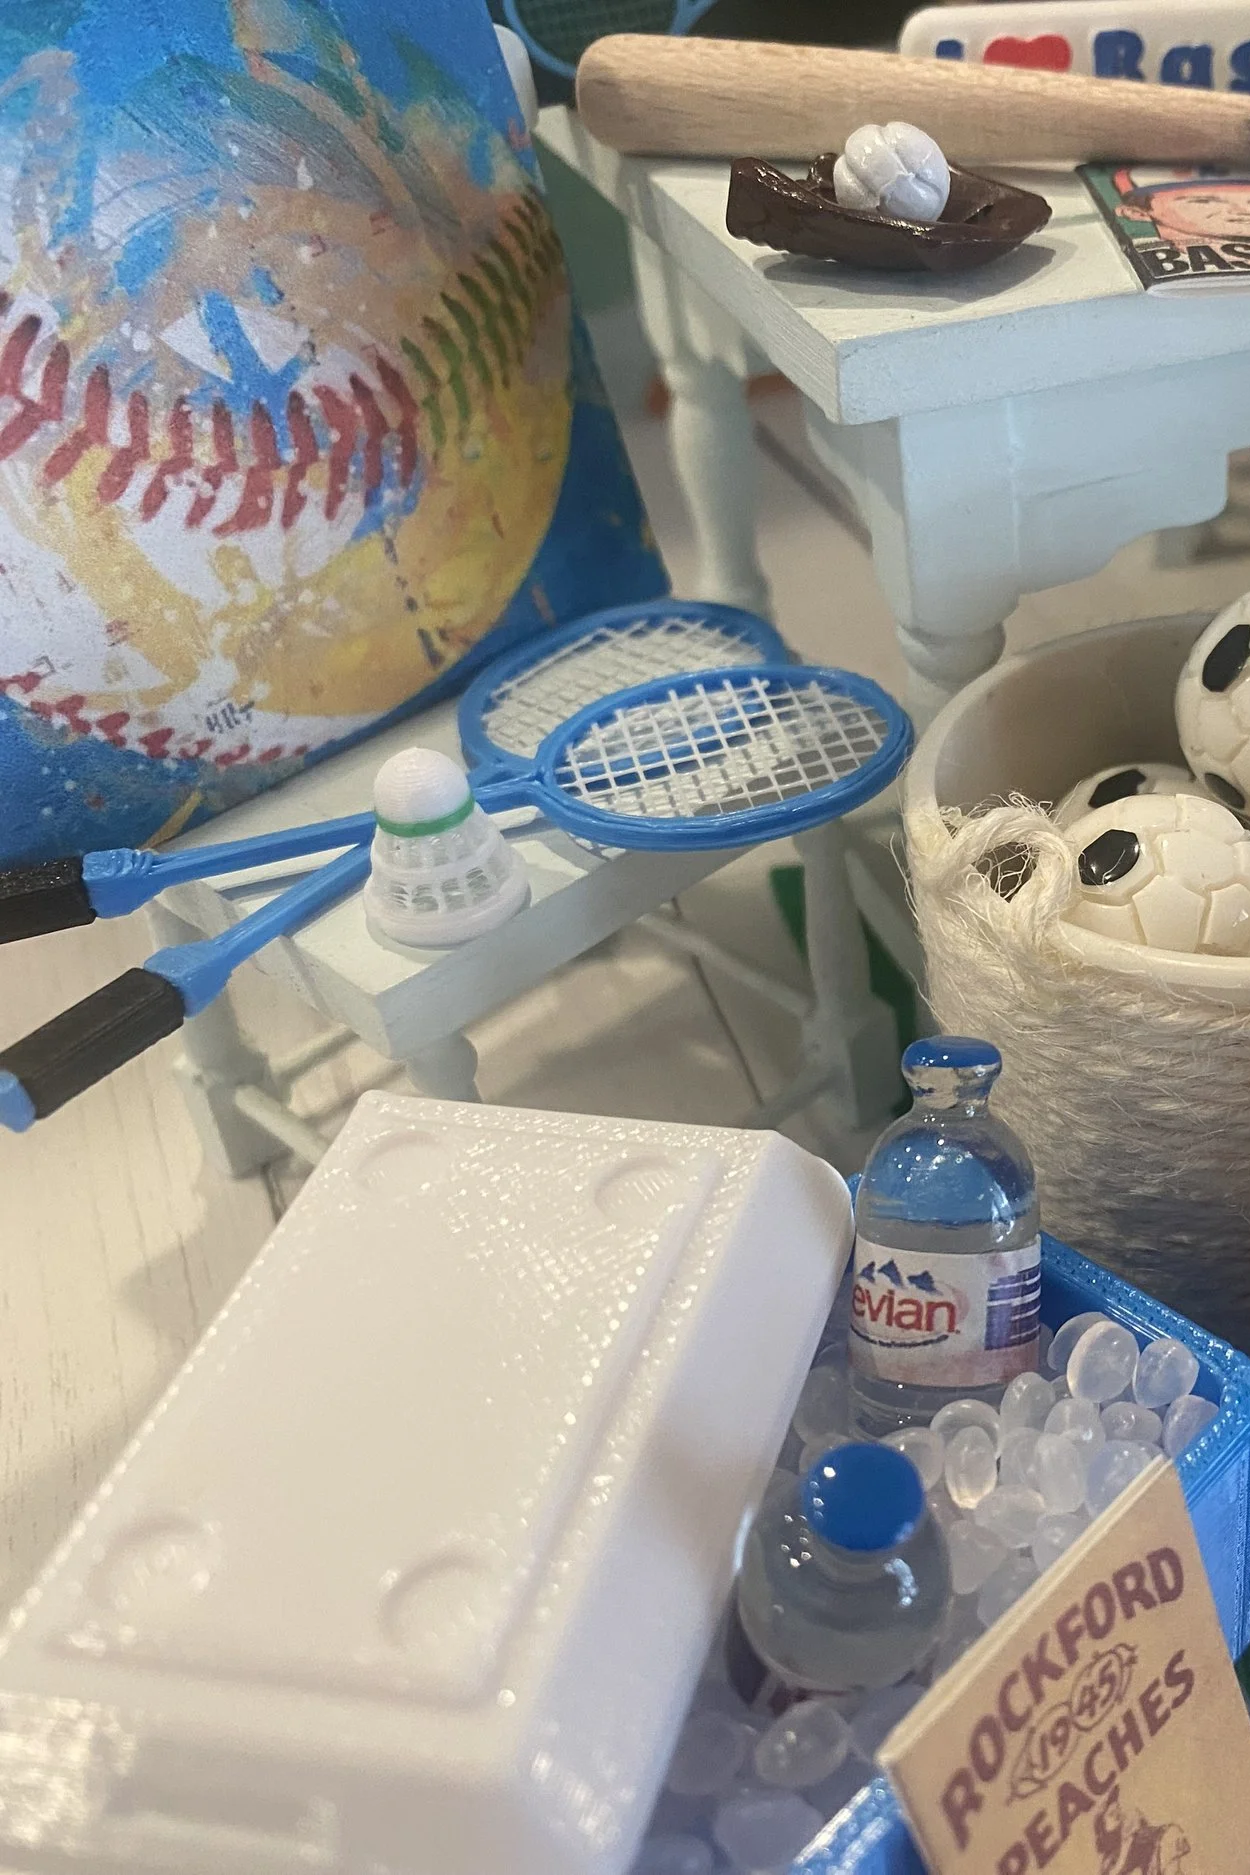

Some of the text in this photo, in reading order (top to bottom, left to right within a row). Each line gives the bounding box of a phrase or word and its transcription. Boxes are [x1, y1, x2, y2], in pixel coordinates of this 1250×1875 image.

[852, 1283, 957, 1333] evian
[939, 1546, 1185, 1852] ROCKFORD
[996, 1649, 1196, 1875] PEACHES
